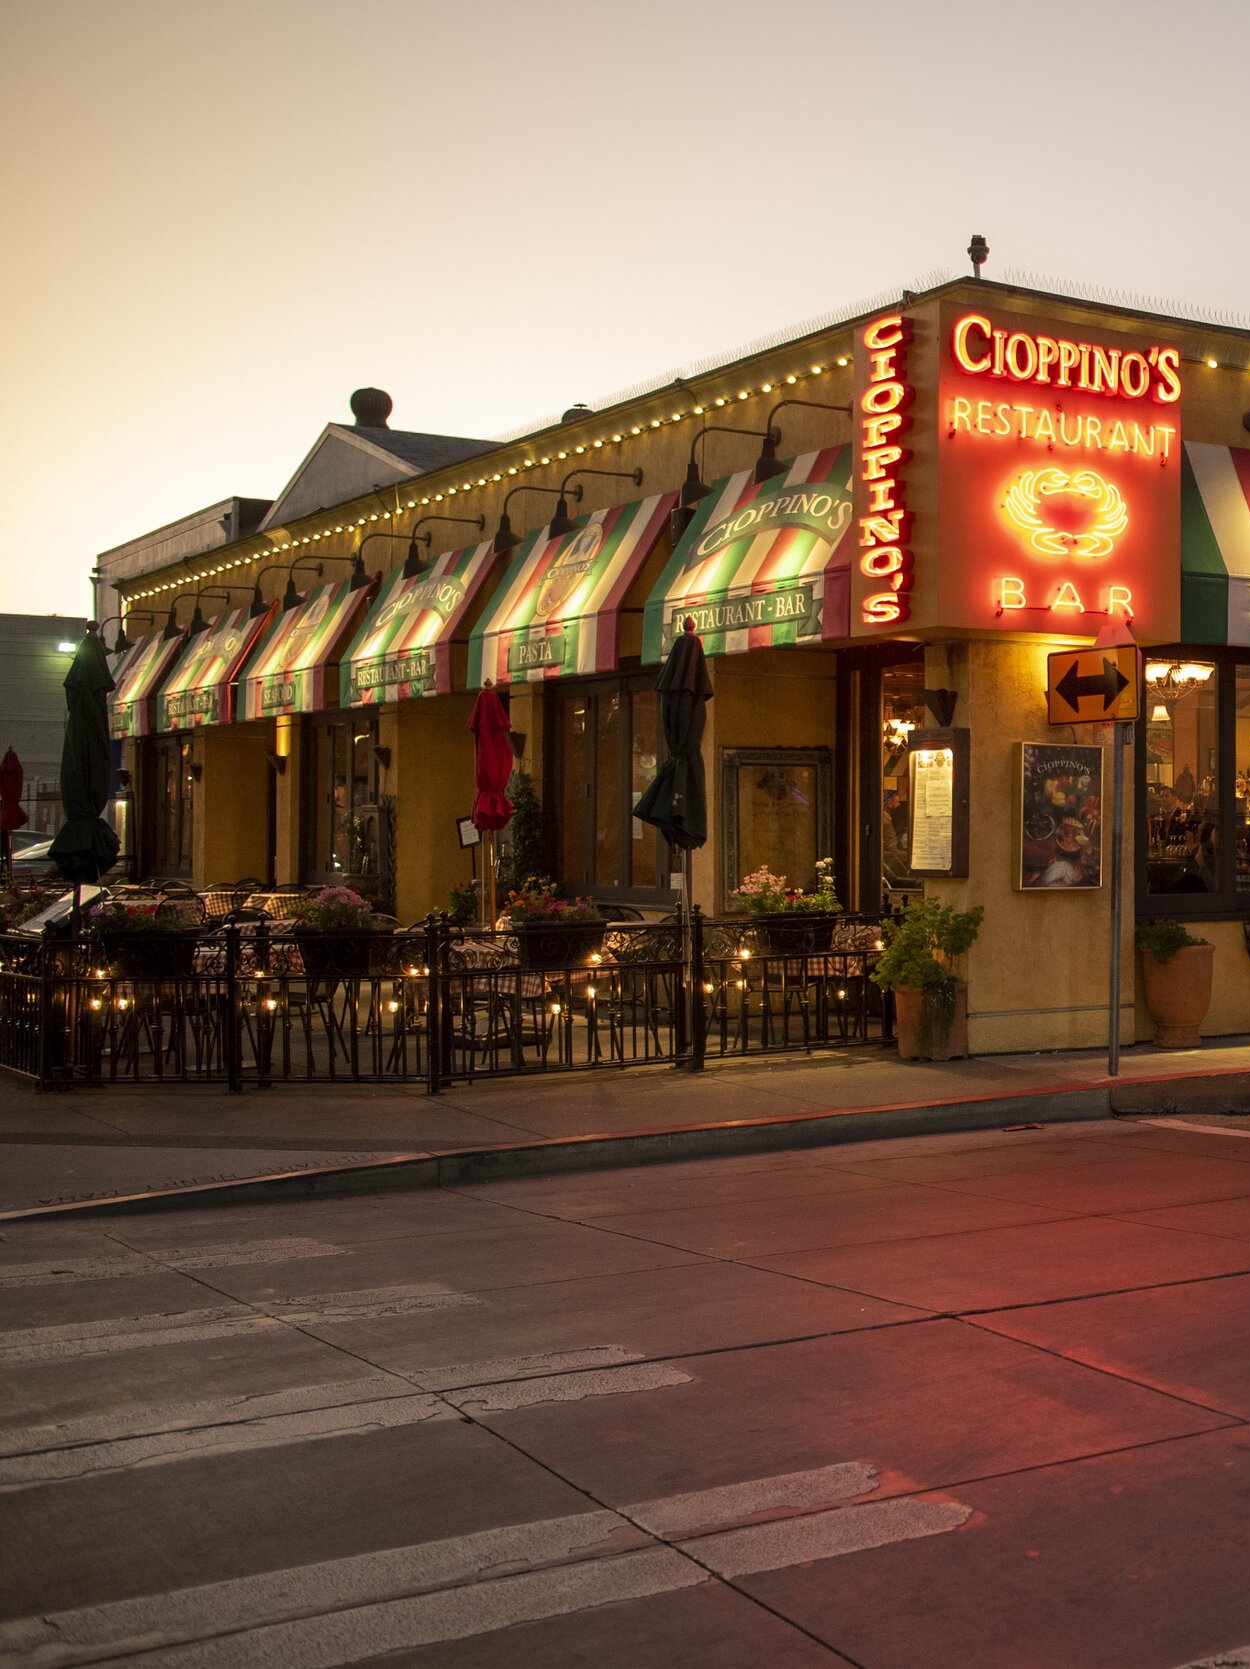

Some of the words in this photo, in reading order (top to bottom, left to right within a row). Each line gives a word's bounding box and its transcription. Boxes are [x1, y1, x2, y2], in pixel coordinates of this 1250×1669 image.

[954, 314, 1182, 403] CIOPPINO'S
[953, 396, 1176, 458] RESTAURANT
[860, 316, 905, 624] CIOPPINO'S
[696, 493, 853, 556] CIOPPINO'S
[375, 582, 462, 628] CIOPPINO'S
[675, 600, 765, 633] RSTAURANT
[775, 593, 806, 617] BAR
[1000, 577, 1135, 617] BAR
[519, 642, 553, 664] PASTA
[1036, 759, 1092, 775] CIOPPINO'S
